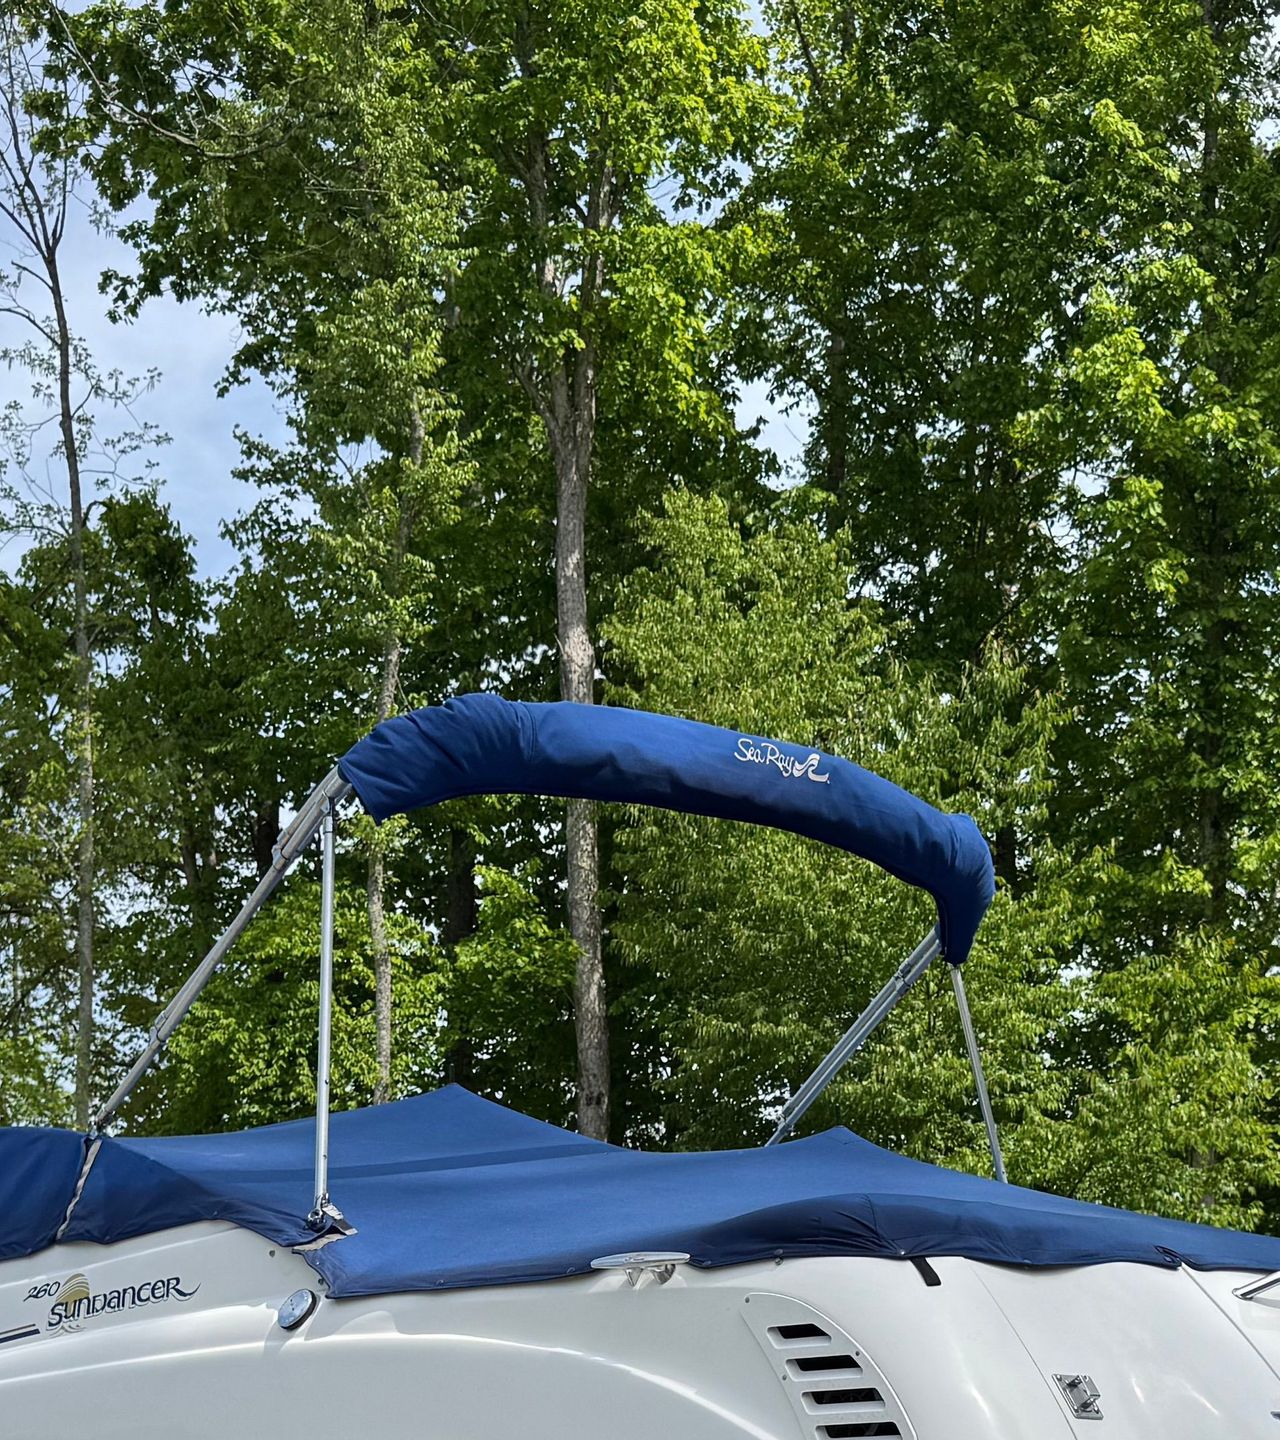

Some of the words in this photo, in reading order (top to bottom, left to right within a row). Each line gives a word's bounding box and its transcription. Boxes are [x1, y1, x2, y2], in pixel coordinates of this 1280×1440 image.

[734, 738, 765, 763] Sea
[761, 742, 794, 778] Ray
[23, 1281, 61, 1302] 260
